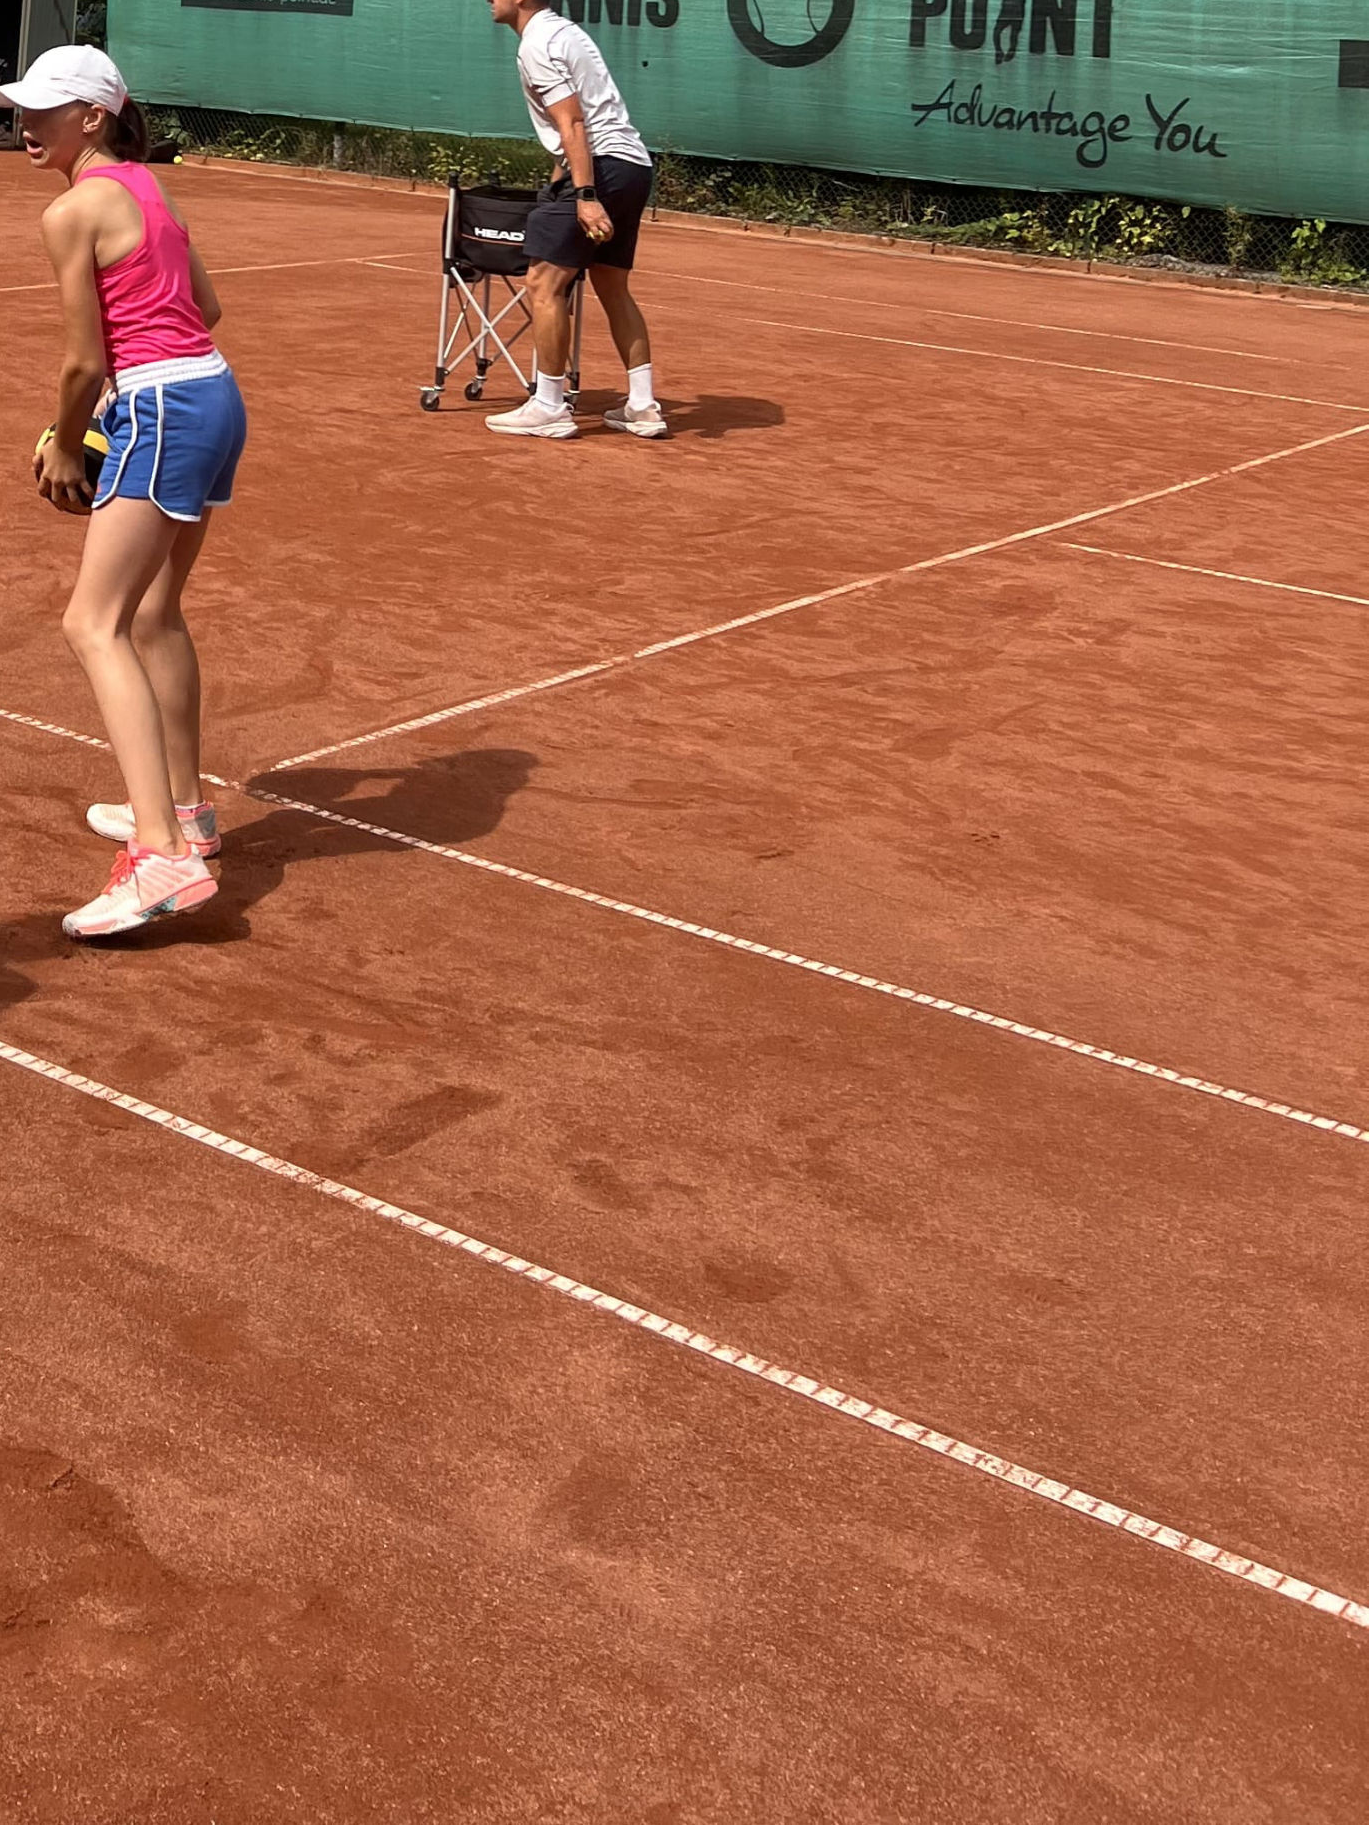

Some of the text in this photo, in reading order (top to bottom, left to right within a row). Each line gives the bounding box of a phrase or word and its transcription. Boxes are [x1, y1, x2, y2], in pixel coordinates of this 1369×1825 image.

[911, 79, 1228, 168] Advantage You
[474, 227, 525, 242] HEAD
